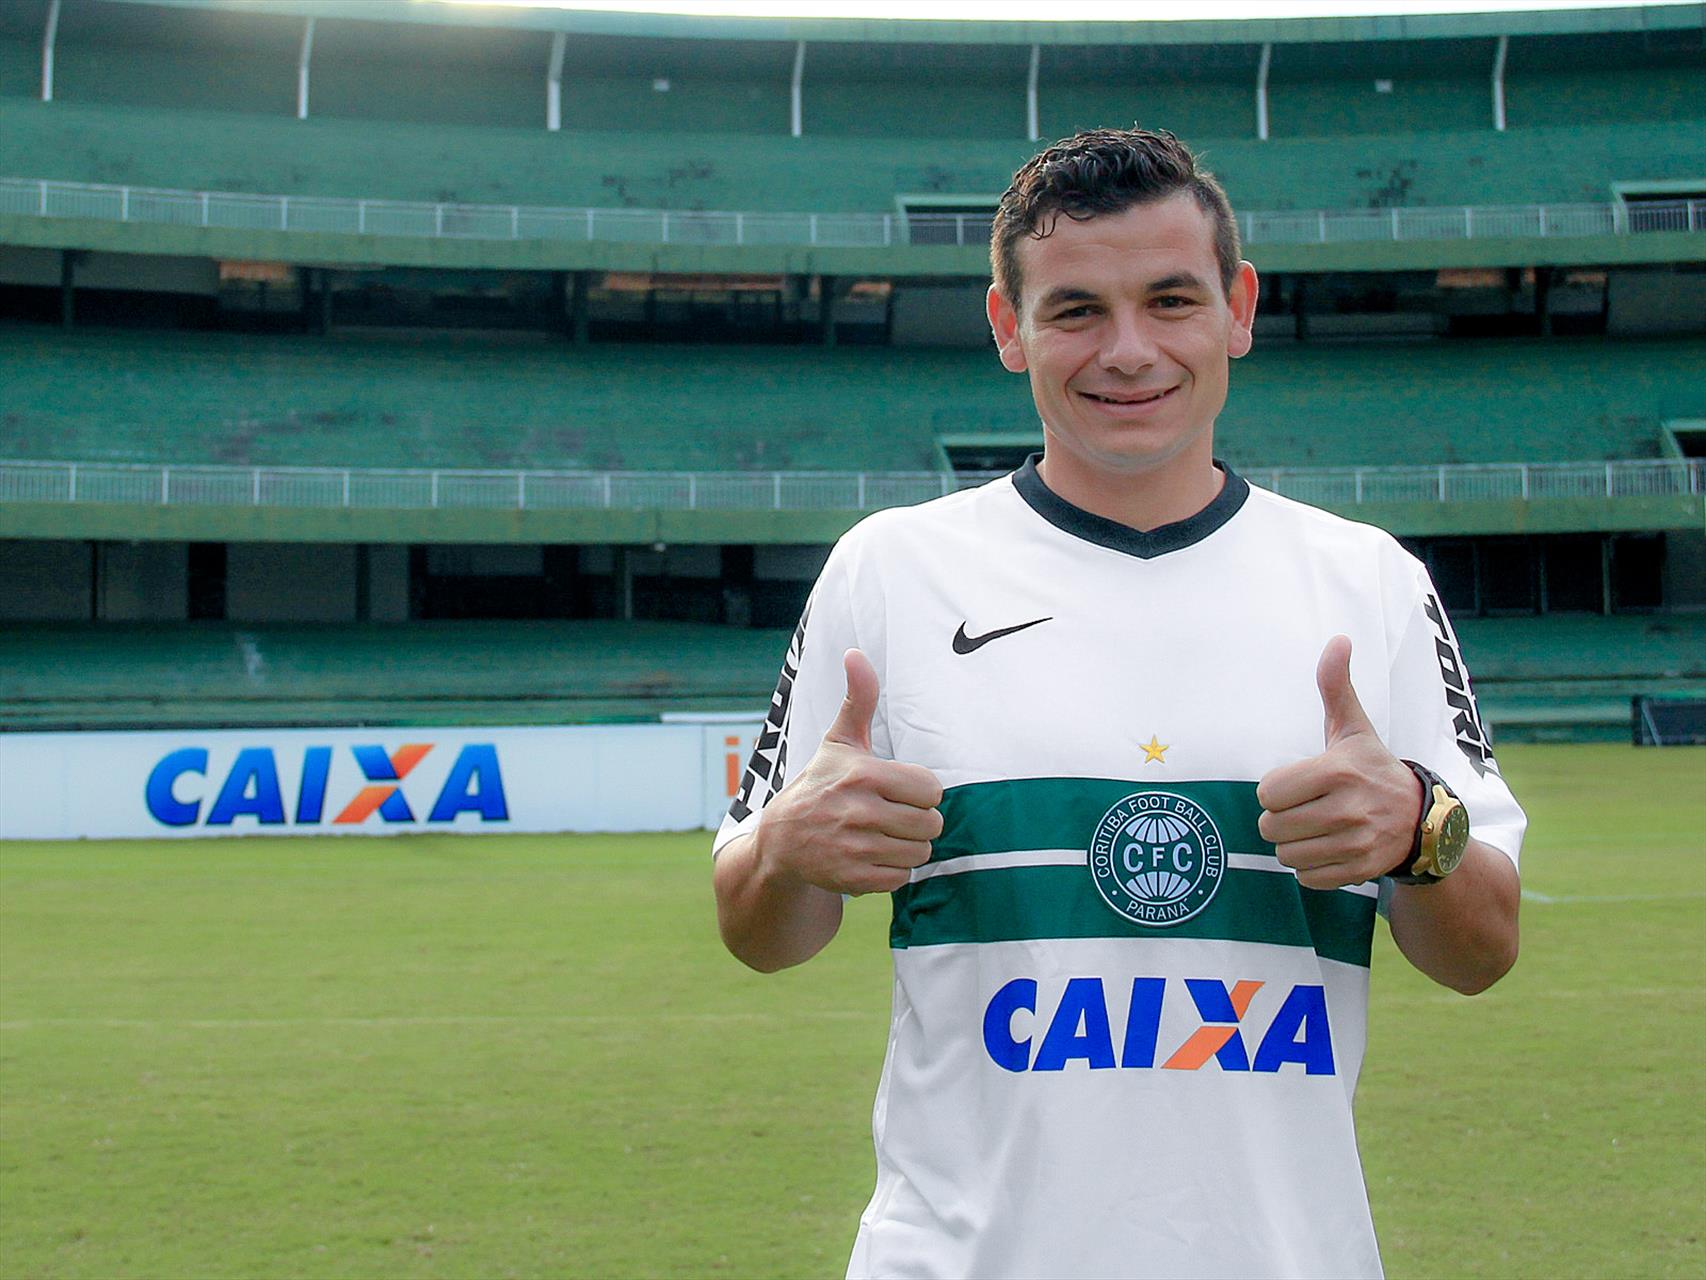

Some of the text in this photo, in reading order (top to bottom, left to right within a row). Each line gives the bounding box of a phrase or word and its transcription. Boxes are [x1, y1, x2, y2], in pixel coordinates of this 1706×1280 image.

[145, 743, 510, 826] CAIXA
[1095, 796, 1220, 878] CORITIBA FOOT BALL CLUB
[1123, 842, 1193, 873] CFC
[1126, 898, 1190, 920] PARANÁ
[983, 977, 1336, 1076] CAIXA
